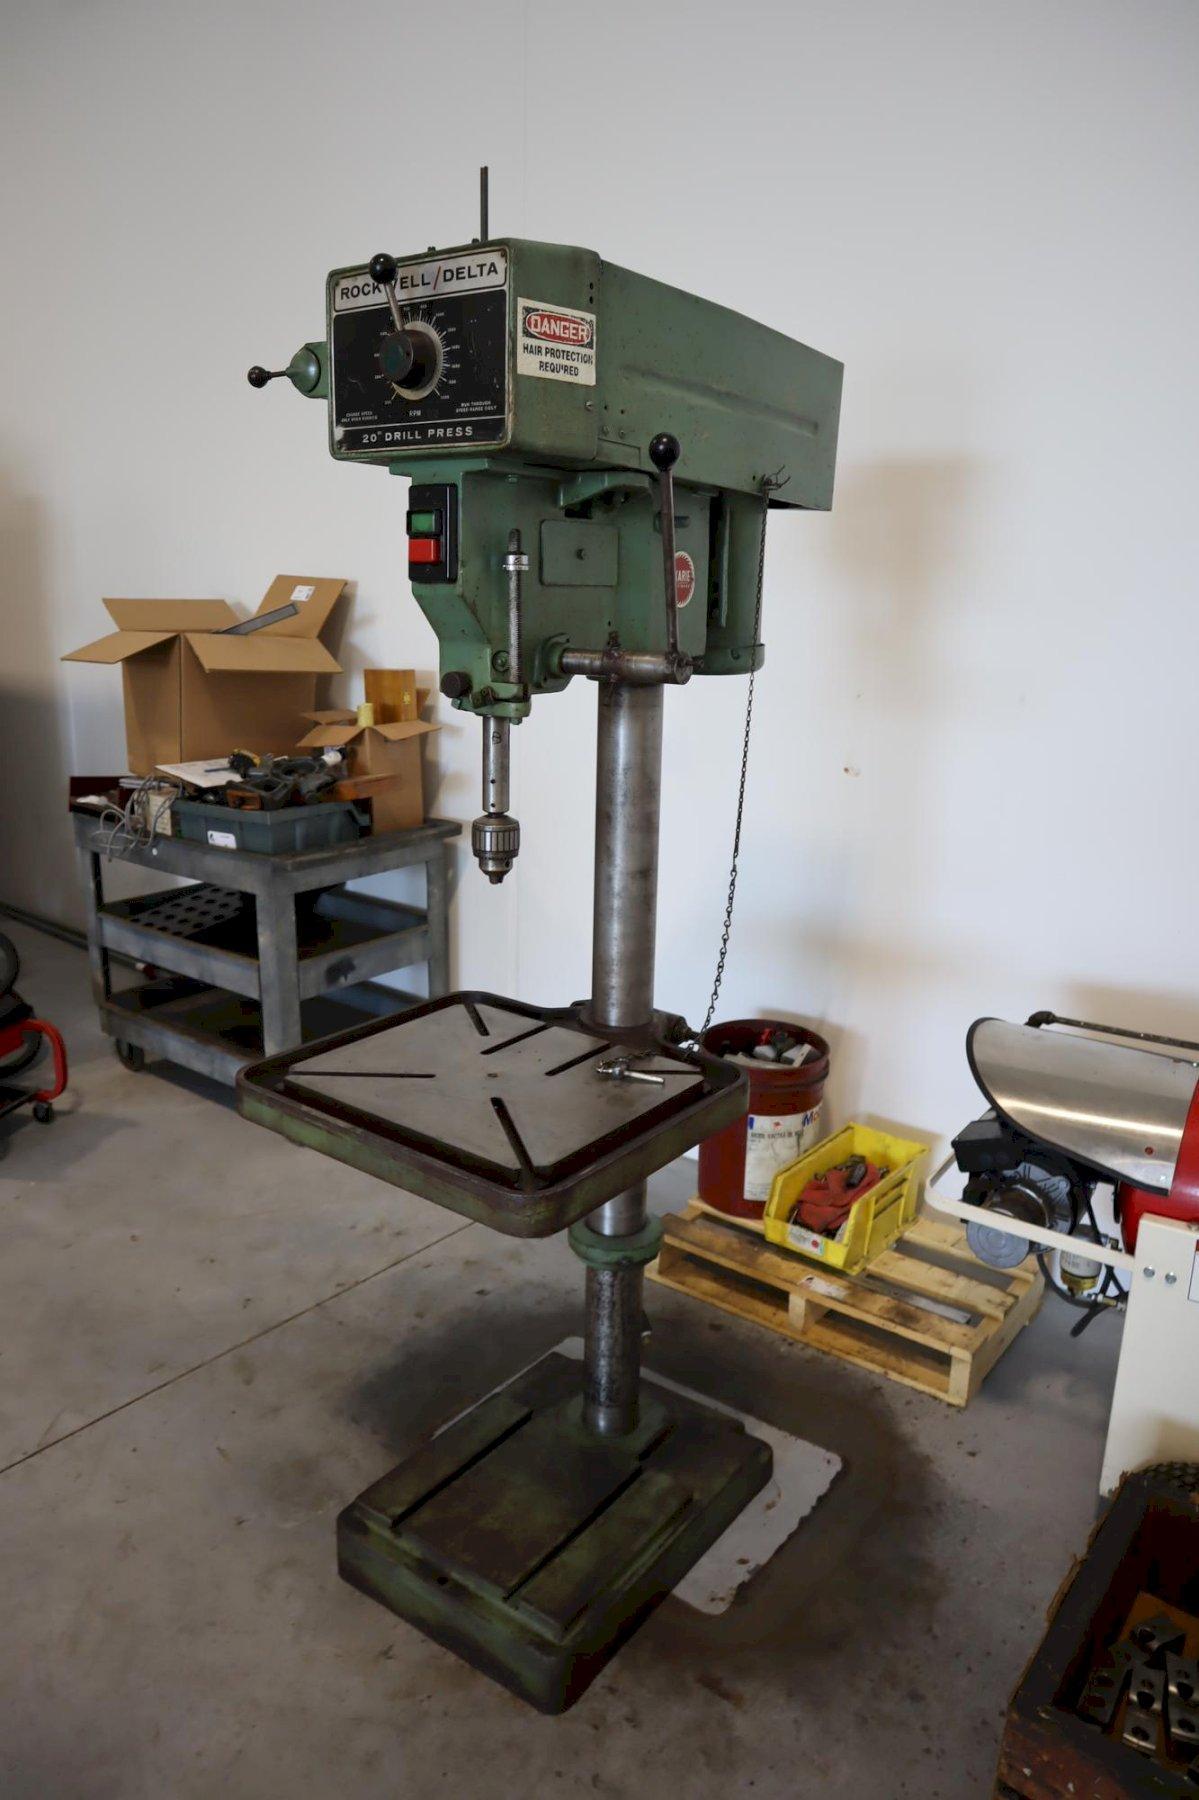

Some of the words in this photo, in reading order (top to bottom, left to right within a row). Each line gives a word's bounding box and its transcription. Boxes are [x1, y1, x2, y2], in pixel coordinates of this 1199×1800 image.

[530, 315, 588, 341] DANGER
[523, 343, 542, 356] HAIR
[545, 347, 593, 365] PROTECTION
[539, 361, 579, 377] REQUIRED
[384, 430, 422, 441] DRILL
[427, 426, 473, 438] PRESS
